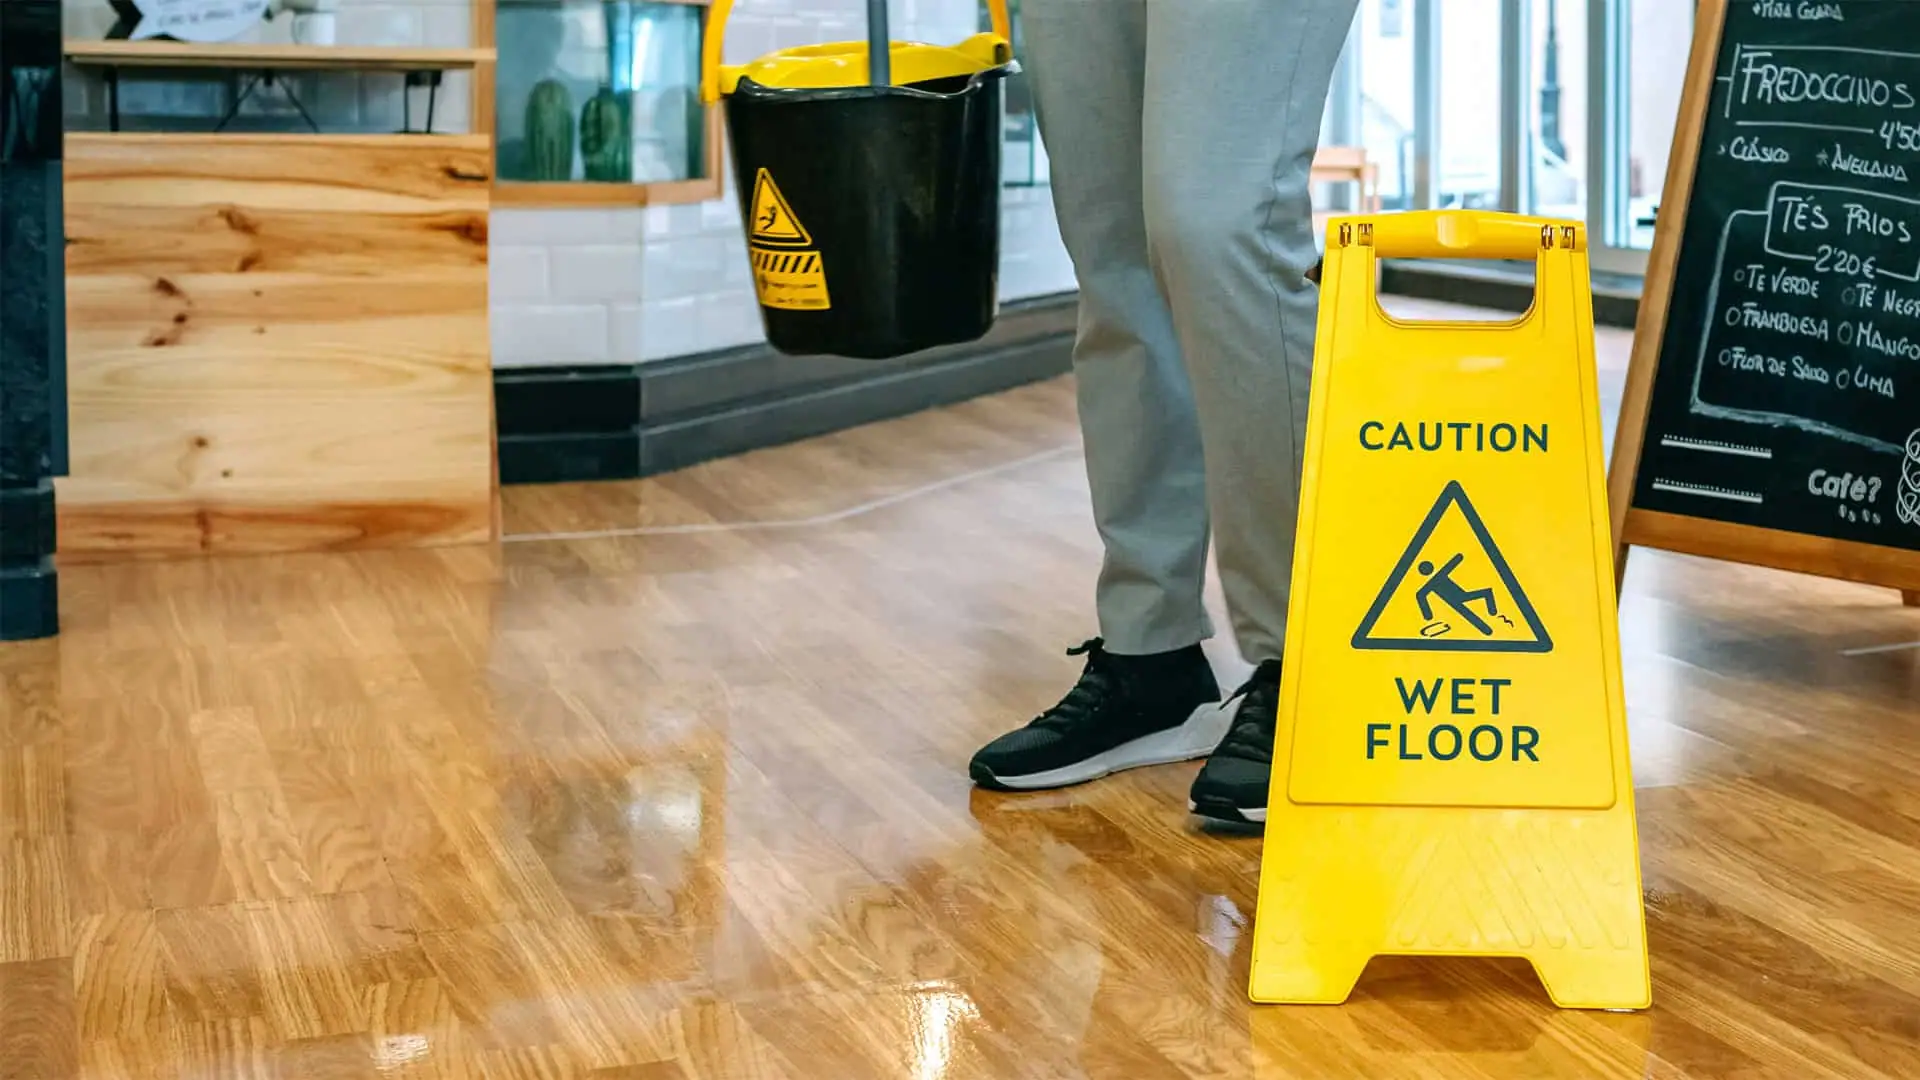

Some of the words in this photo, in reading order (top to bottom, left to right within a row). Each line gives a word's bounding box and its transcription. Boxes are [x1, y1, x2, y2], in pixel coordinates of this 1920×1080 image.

[1741, 52, 1915, 108] FREDOCCINOS
[1831, 143, 1908, 182] AVELLANA
[1777, 195, 1829, 233] TÉS
[1771, 266, 1820, 299] VERDE
[1855, 282, 1877, 308] TÉ
[1742, 301, 1829, 342] FRAMBOESA
[1855, 320, 1920, 361] MANGO
[1732, 346, 1764, 374] FLOR
[1767, 356, 1787, 377] DE
[1854, 364, 1894, 399] LIMA
[1360, 421, 1548, 453] CAUTION
[1808, 468, 1882, 503] Café?
[1395, 677, 1512, 715] WET
[1366, 724, 1540, 762] FLOOR
